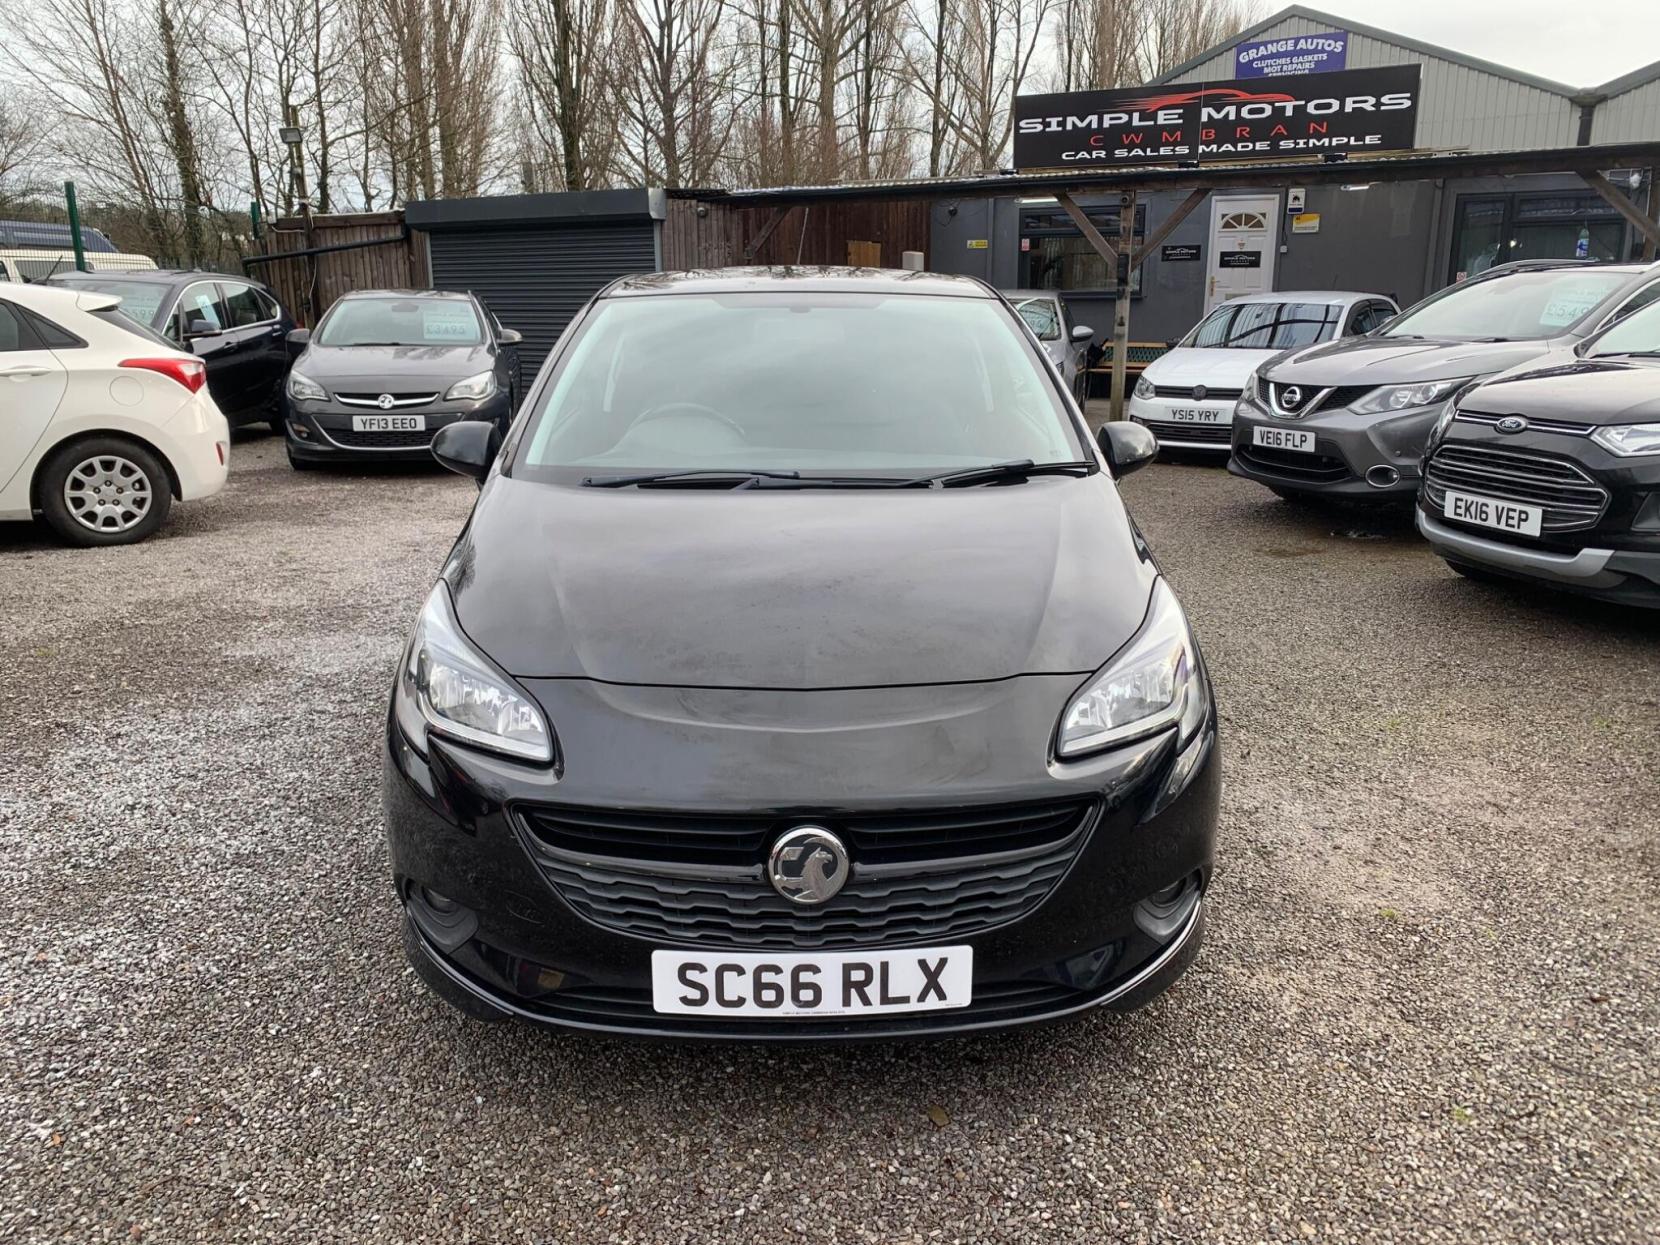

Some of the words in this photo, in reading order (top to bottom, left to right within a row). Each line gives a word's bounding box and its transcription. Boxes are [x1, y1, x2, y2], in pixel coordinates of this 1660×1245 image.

[1239, 40, 1295, 63] GRANGE
[1296, 38, 1345, 53] AUTOS
[1252, 57, 1291, 68] CLUTCHES
[1292, 53, 1328, 63] GASKETS
[1263, 66, 1282, 74] MOT
[1282, 61, 1316, 71] REPAIRS
[1019, 109, 1184, 134] SIMPLE
[1201, 93, 1412, 123] MOTORS
[1090, 121, 1328, 147] CWMBRAN
[1061, 150, 1107, 161] CAR
[1114, 145, 1190, 158] SALES
[1199, 140, 1271, 154] MADE
[1279, 134, 1382, 149] SIMPLE
[360, 417, 389, 430] YF13
[392, 417, 417, 429] EEO
[1171, 409, 1195, 421] YS15
[1197, 410, 1220, 422] YRY
[1259, 430, 1282, 446] VE16
[1284, 432, 1308, 449] FLP
[1453, 497, 1490, 523] EK16
[1495, 504, 1529, 530] VEP
[677, 962, 823, 1009] SC66
[841, 956, 949, 1008] RLX
